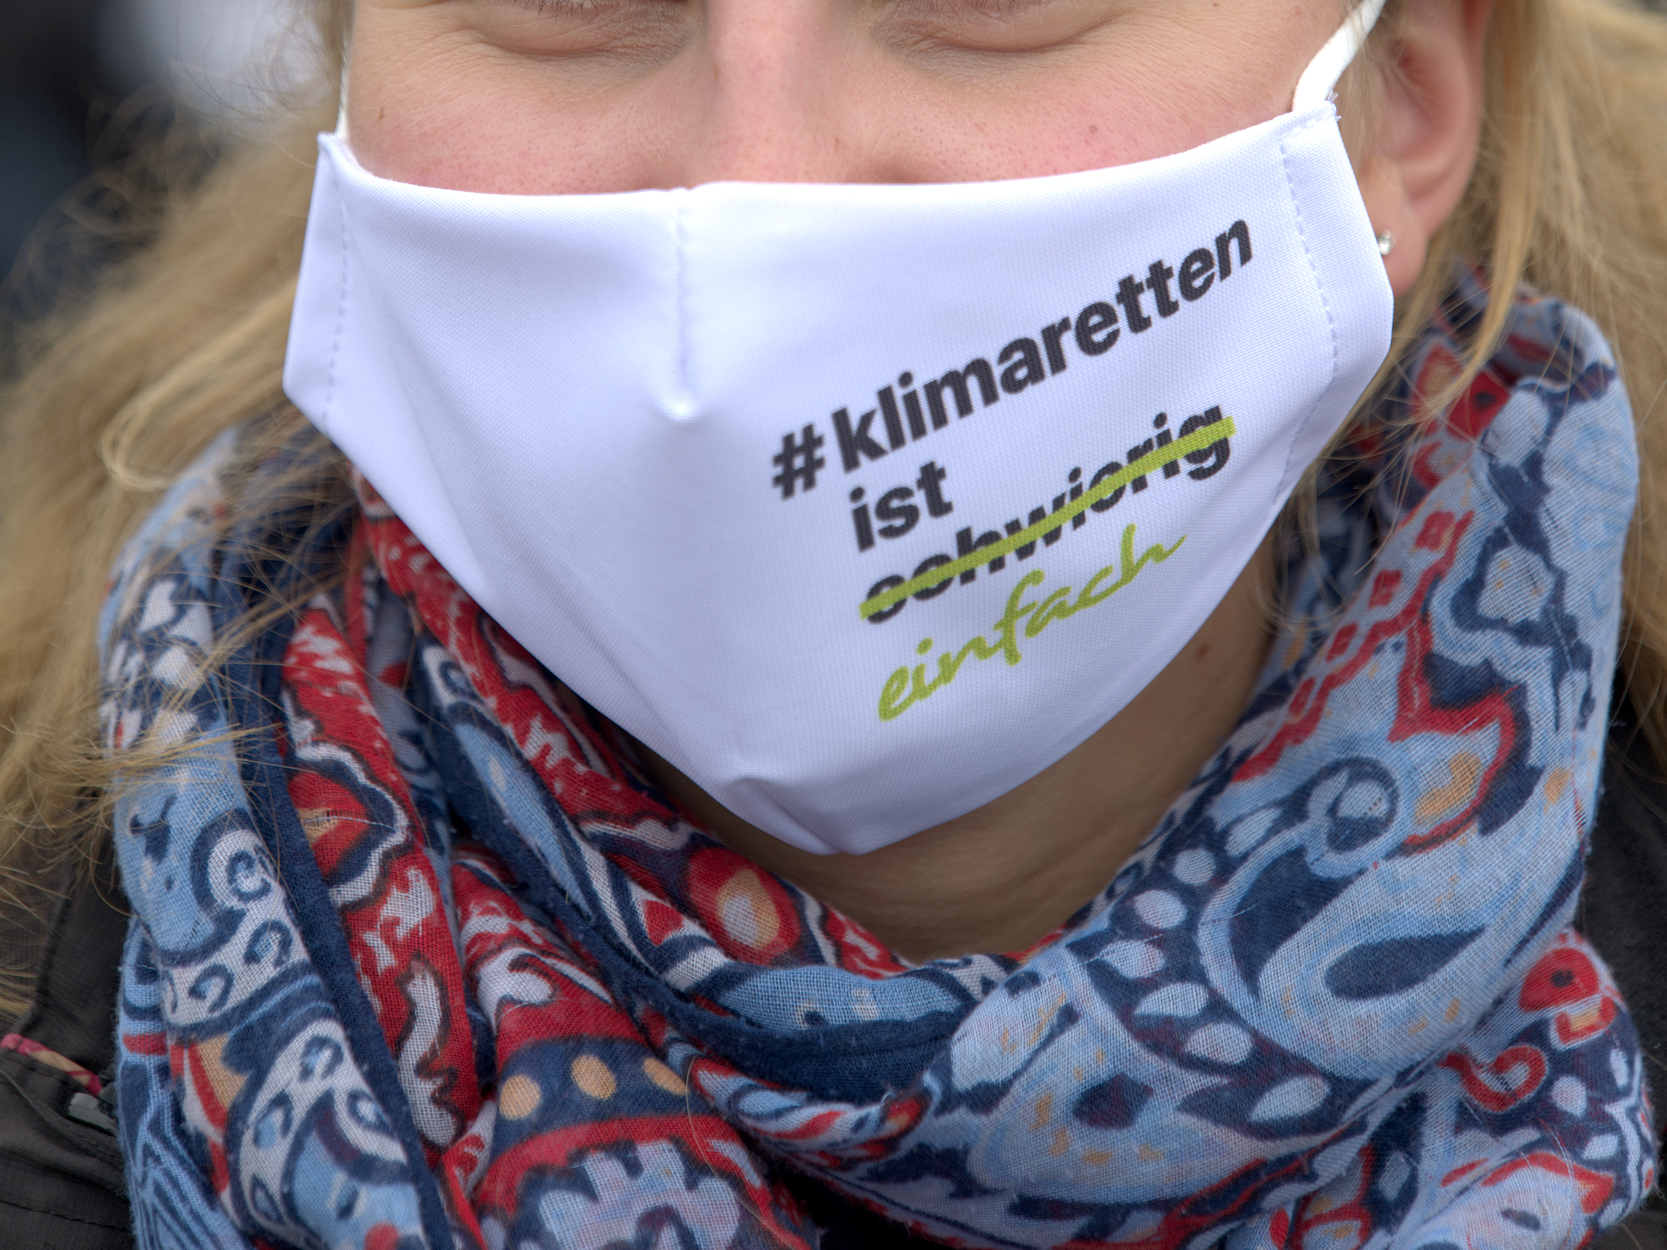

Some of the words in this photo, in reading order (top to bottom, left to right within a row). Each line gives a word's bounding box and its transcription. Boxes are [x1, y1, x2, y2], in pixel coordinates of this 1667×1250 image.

[772, 218, 1254, 501] #klimaretten
[848, 459, 954, 554] ist
[877, 522, 1188, 723] einfach
